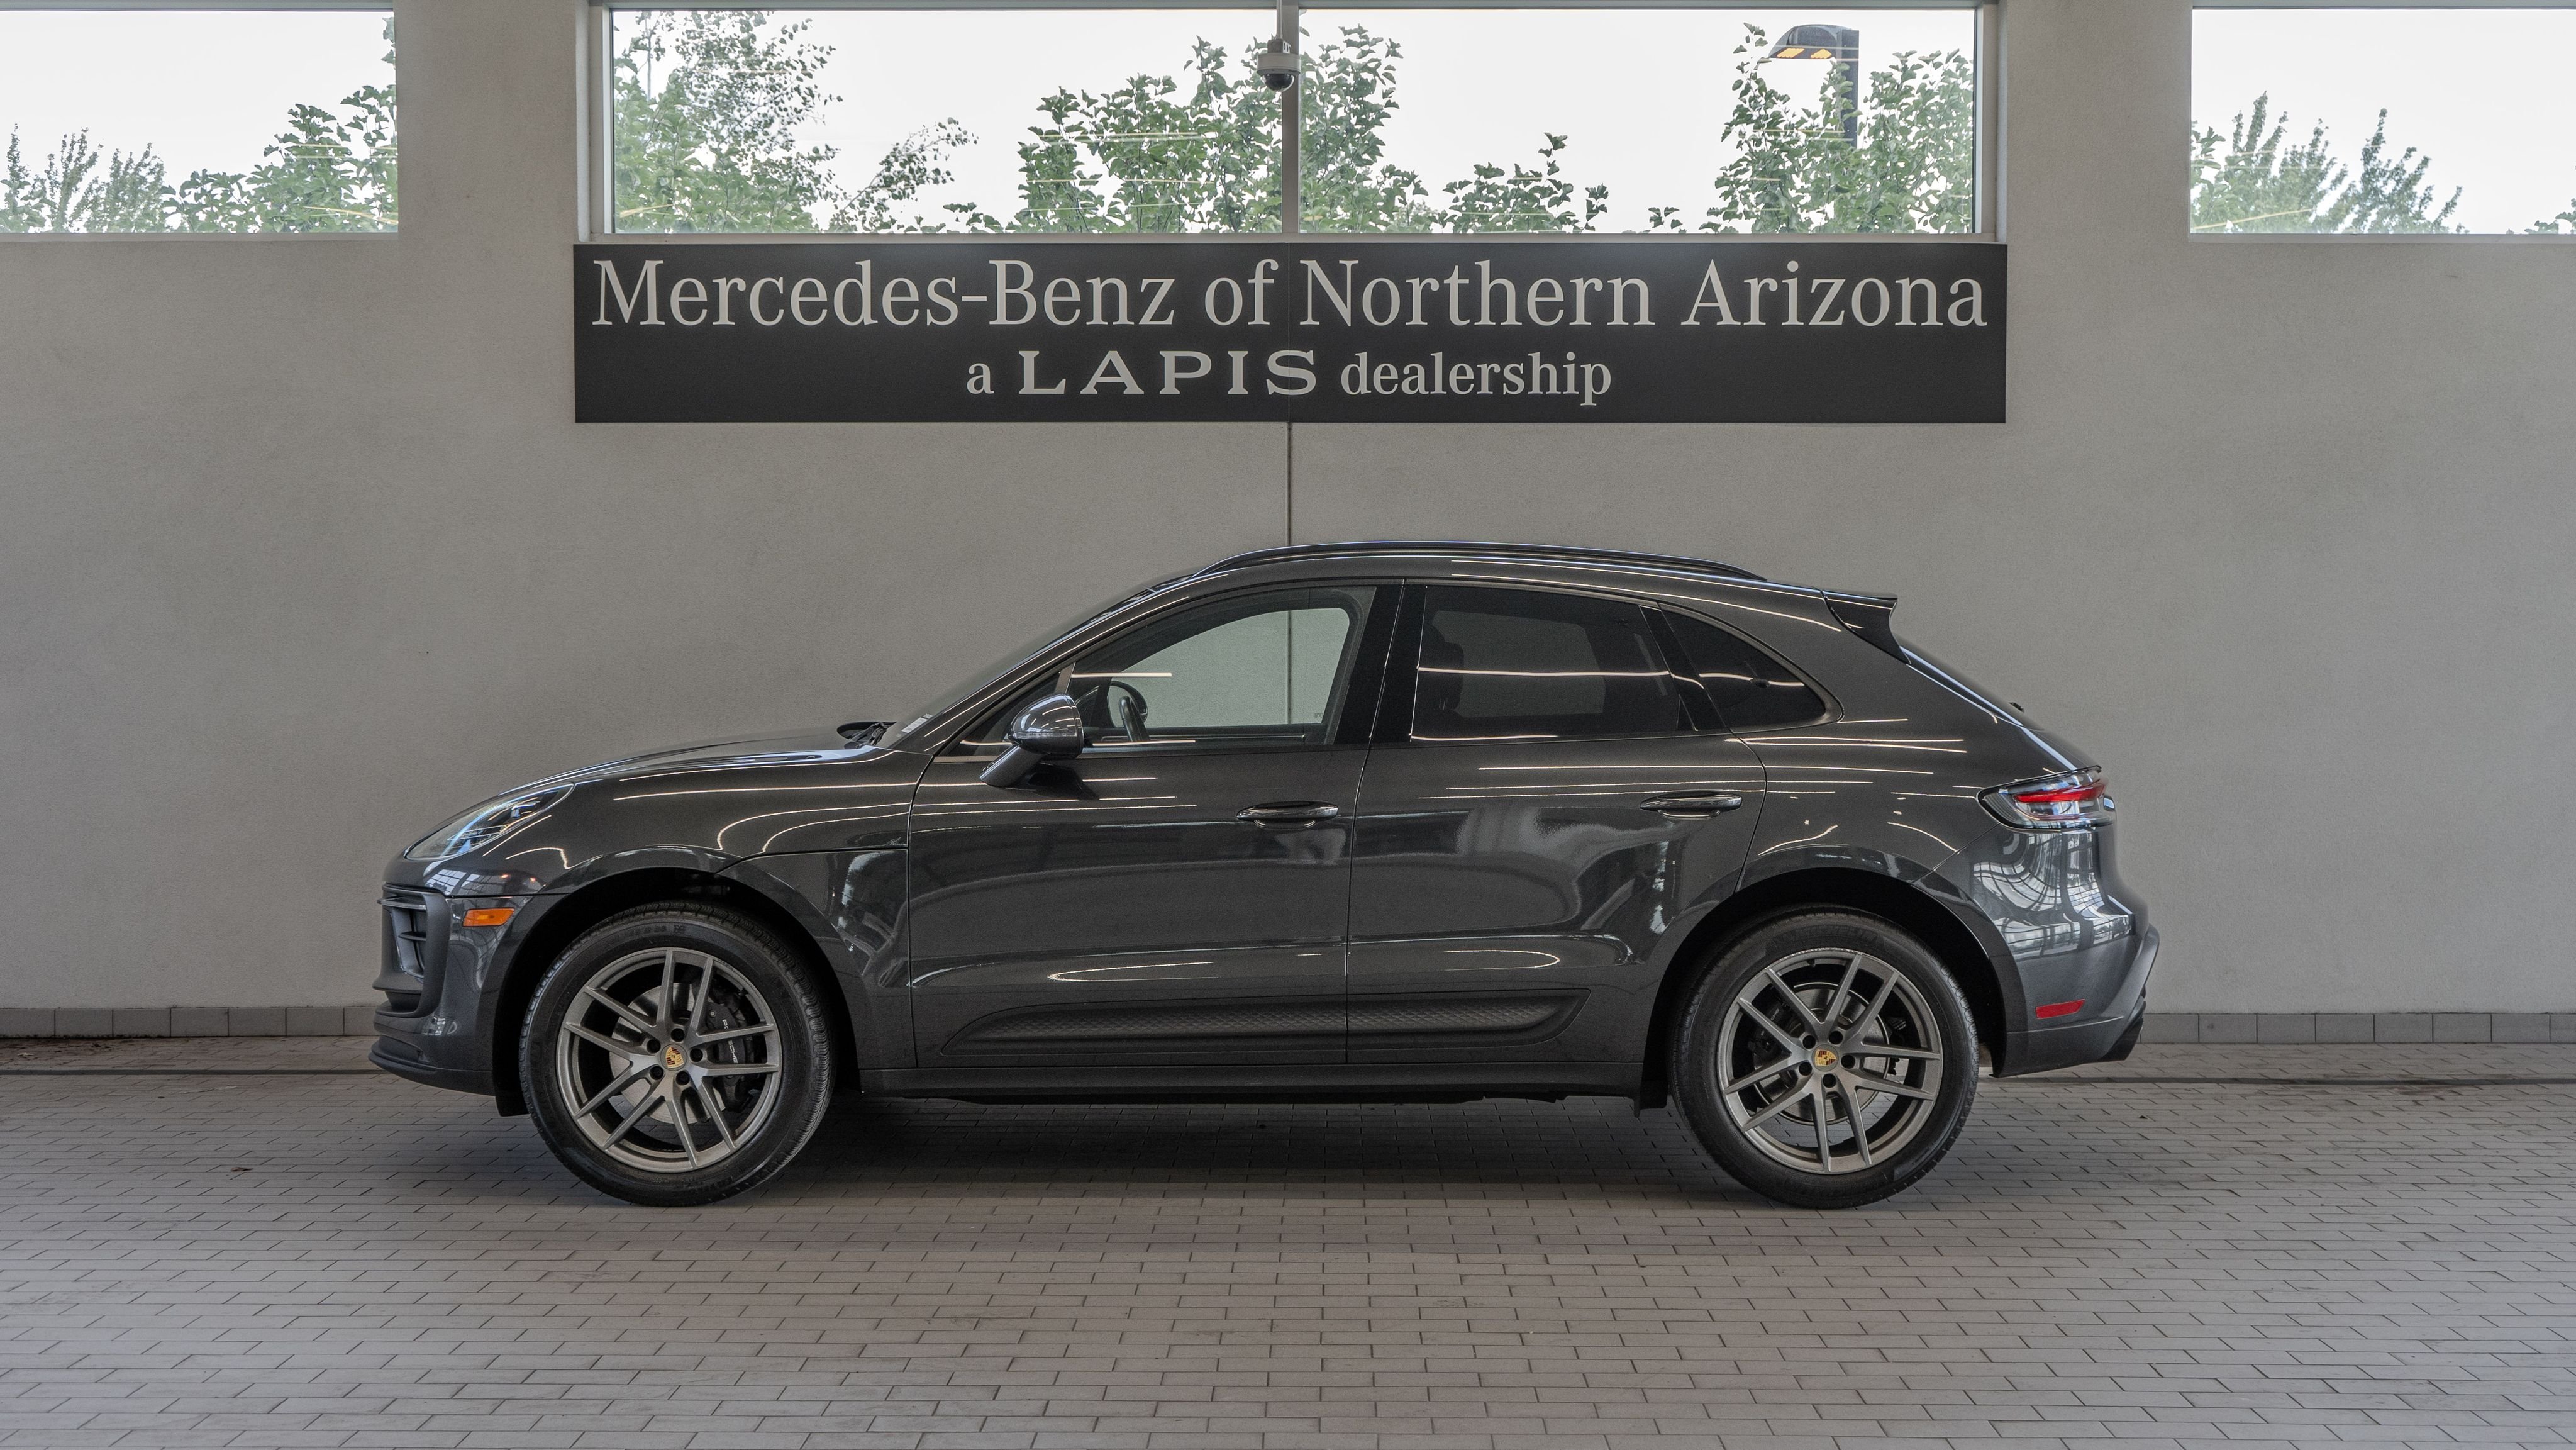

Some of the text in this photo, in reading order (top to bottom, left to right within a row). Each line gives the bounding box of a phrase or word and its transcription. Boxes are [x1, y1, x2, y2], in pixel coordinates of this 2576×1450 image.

[591, 258, 1988, 326] Mercedes-Benz of Northern Arizona
[966, 349, 1611, 406] a LAPIS dealership
[722, 1018, 739, 1064] PSCHE
